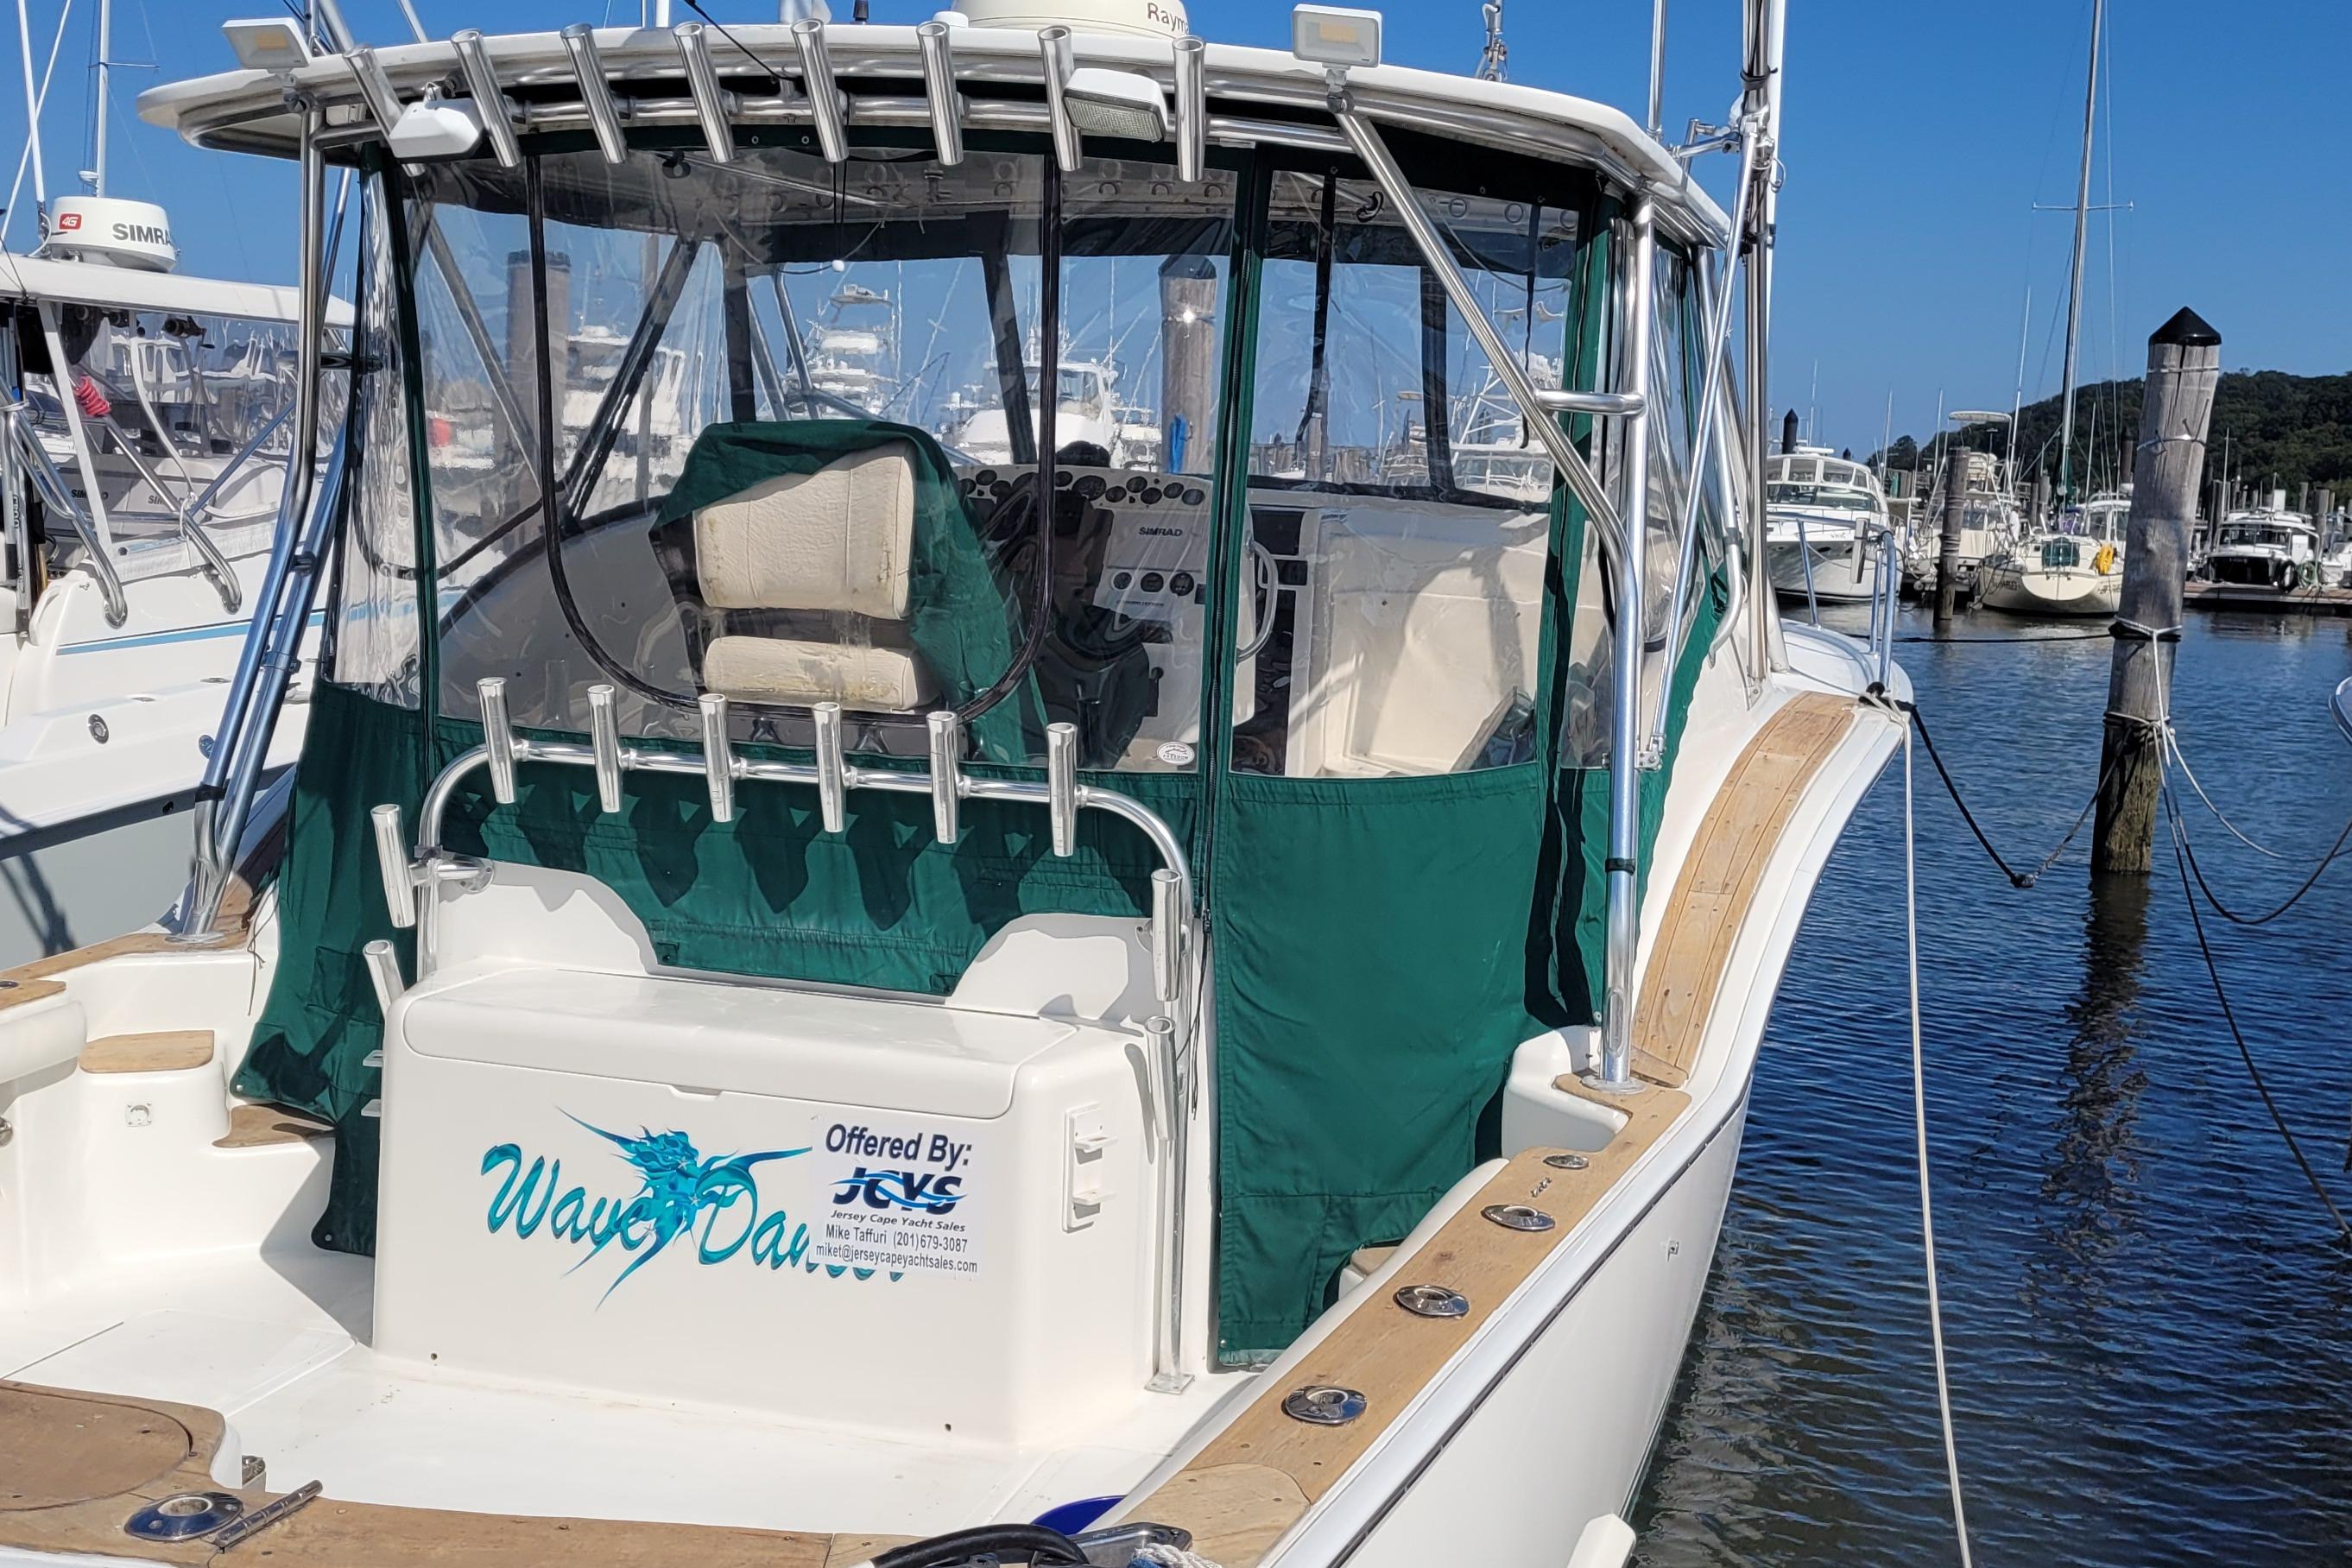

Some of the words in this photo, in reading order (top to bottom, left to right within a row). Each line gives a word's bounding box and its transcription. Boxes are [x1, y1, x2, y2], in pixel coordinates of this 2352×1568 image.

[61, 216, 79, 227] 4G
[1138, 526, 1183, 537] SIMRAD
[825, 1123, 923, 1160] Offered
[926, 1134, 972, 1172] By:
[480, 1143, 650, 1251] Wave
[832, 1167, 963, 1216] JCYS
[831, 1210, 867, 1223] Jersey
[869, 1214, 898, 1226] Cape
[901, 1217, 933, 1229] Yacht
[935, 1221, 965, 1232] Sales
[825, 1223, 850, 1241] Mike
[853, 1226, 888, 1245] Taffuri
[893, 1230, 968, 1254] (201)679-3087
[816, 1243, 977, 1274] miket@jerseycapeyachtsales.com
